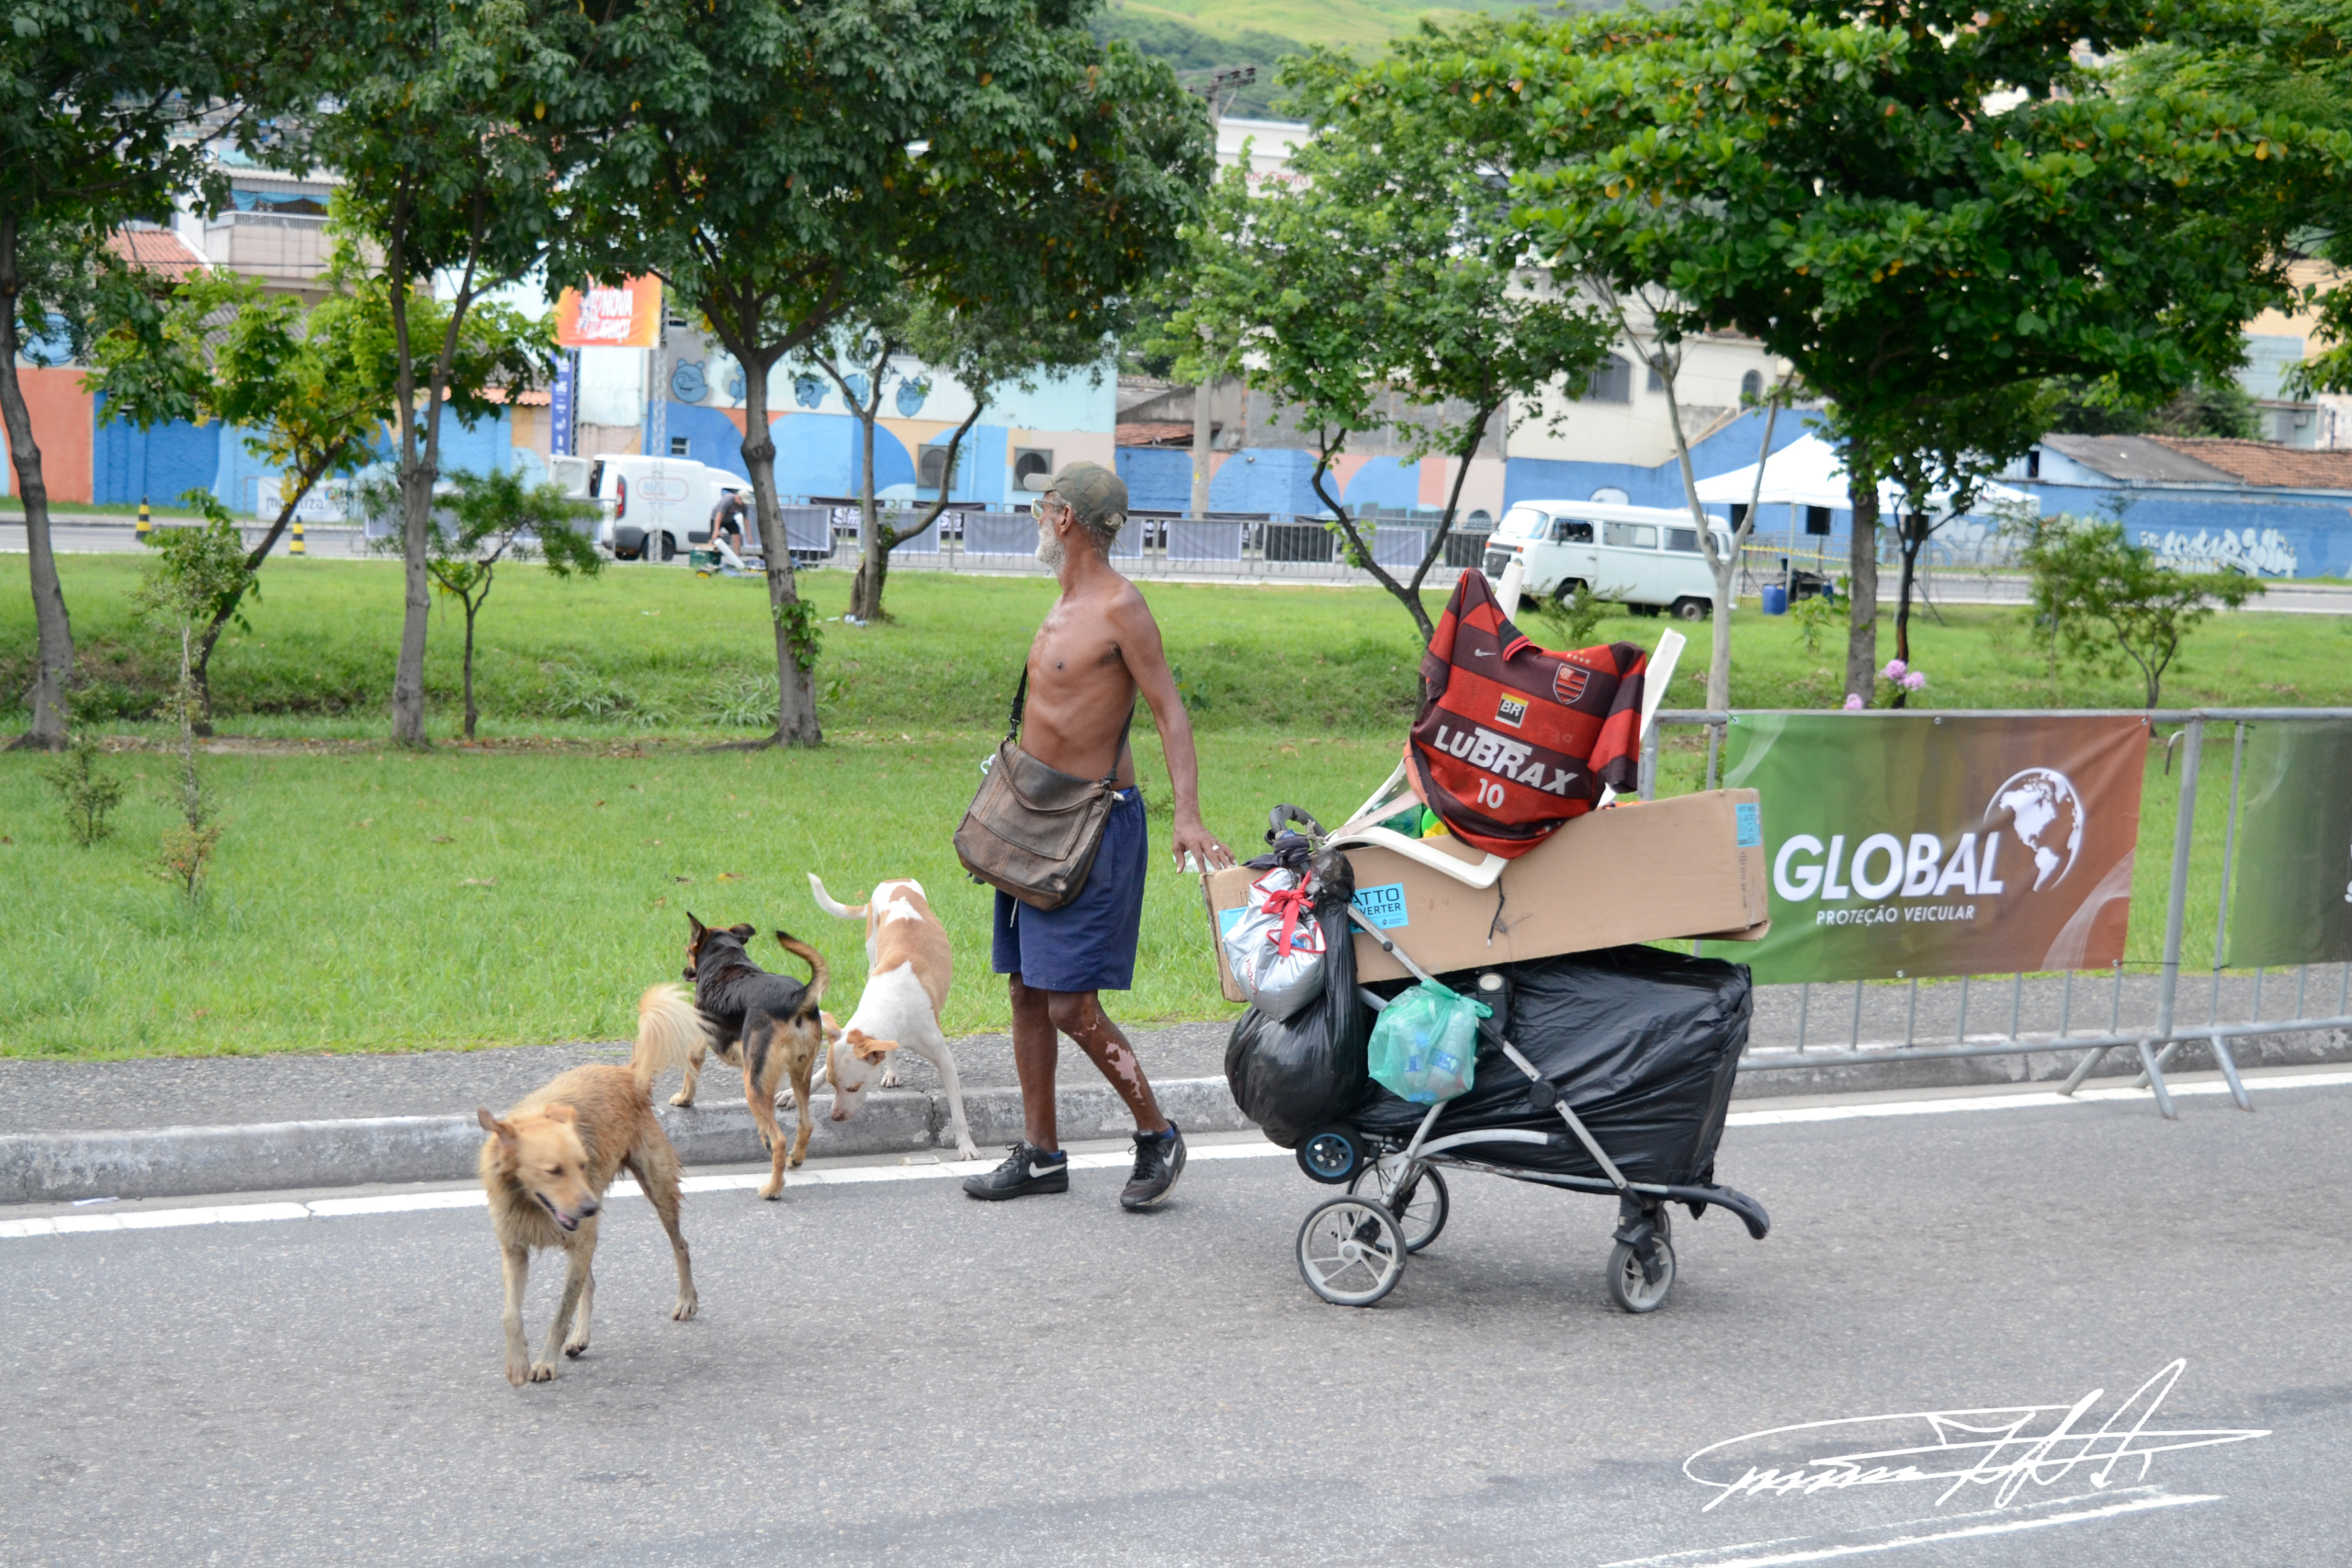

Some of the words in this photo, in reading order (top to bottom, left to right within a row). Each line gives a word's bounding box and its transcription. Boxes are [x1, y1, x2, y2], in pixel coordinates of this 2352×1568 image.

[601, 289, 633, 317] NOVA
[1499, 700, 1522, 716] BR
[1433, 725, 1579, 795] LUBRAX
[1476, 778, 1505, 809] 10
[1773, 831, 2004, 902] GLOBAL
[1353, 887, 1400, 907] ATTO
[1360, 902, 1402, 916] VERTER
[1815, 905, 1897, 926] PROTEÇÃO
[1904, 905, 1974, 922] VEICULAR
